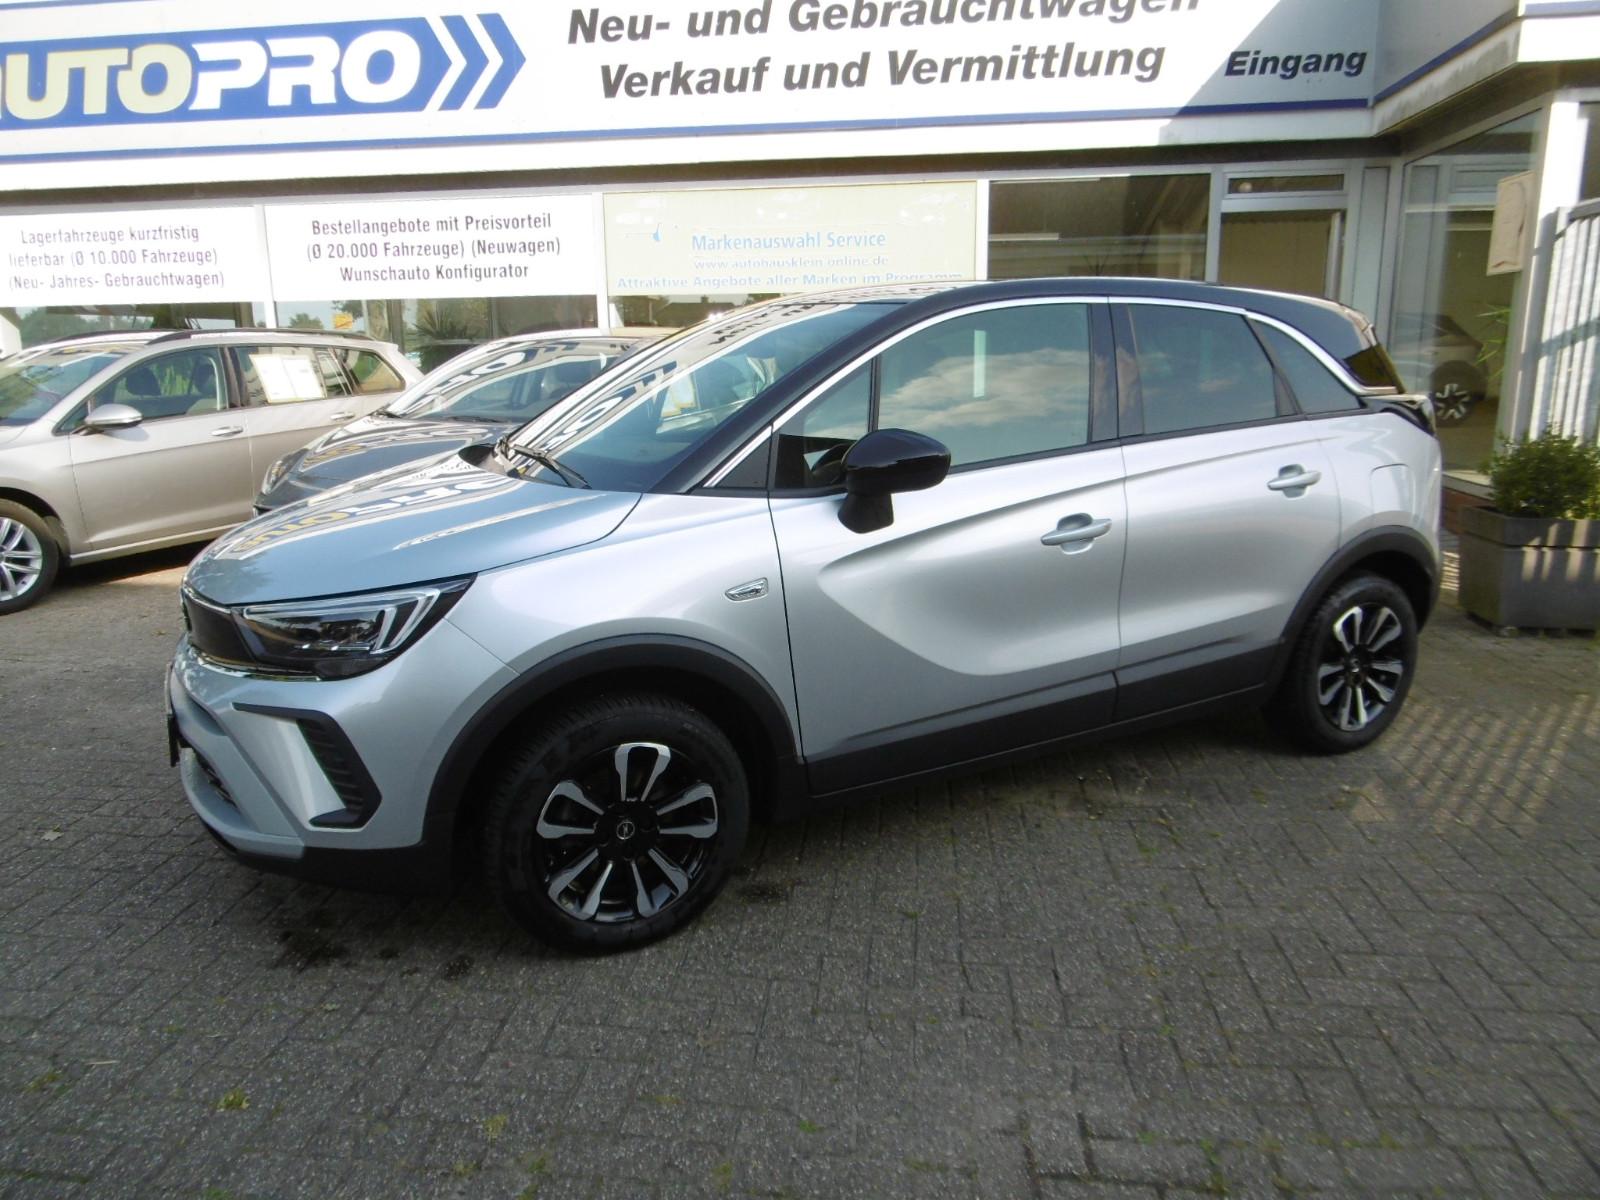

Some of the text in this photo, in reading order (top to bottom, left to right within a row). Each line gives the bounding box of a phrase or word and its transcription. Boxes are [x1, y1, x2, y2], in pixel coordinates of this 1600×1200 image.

[568, 8, 670, 44] Neu-
[687, 0, 772, 36] und
[601, 42, 1166, 99] Verkauf und Vermittlung
[1224, 48, 1367, 78] Eingang
[0, 30, 421, 121] UTOPRO
[20, 224, 200, 246] Lagerfahrzeuge kurzfristig
[311, 212, 553, 237] Bestellangebote mit Preisvorteil
[327, 242, 379, 260] 20.000
[383, 239, 466, 259] Fahrzeuge)
[471, 236, 562, 259] (Neuwagen)
[691, 231, 887, 251] Markenauswahl Service
[9, 252, 65, 268] lieferbar
[91, 249, 137, 266] 10.000
[142, 247, 218, 266] Fahrzeuge)
[9, 271, 225, 291] (Neu- Jahres- Gebrauchtwagen)
[339, 263, 529, 283] Wunschauto Konfigurator
[617, 278, 688, 289] Attraktive
[693, 274, 761, 290] Angebote
[765, 275, 797, 286] aller
[802, 273, 858, 286] Marken
[863, 274, 881, 285] im
